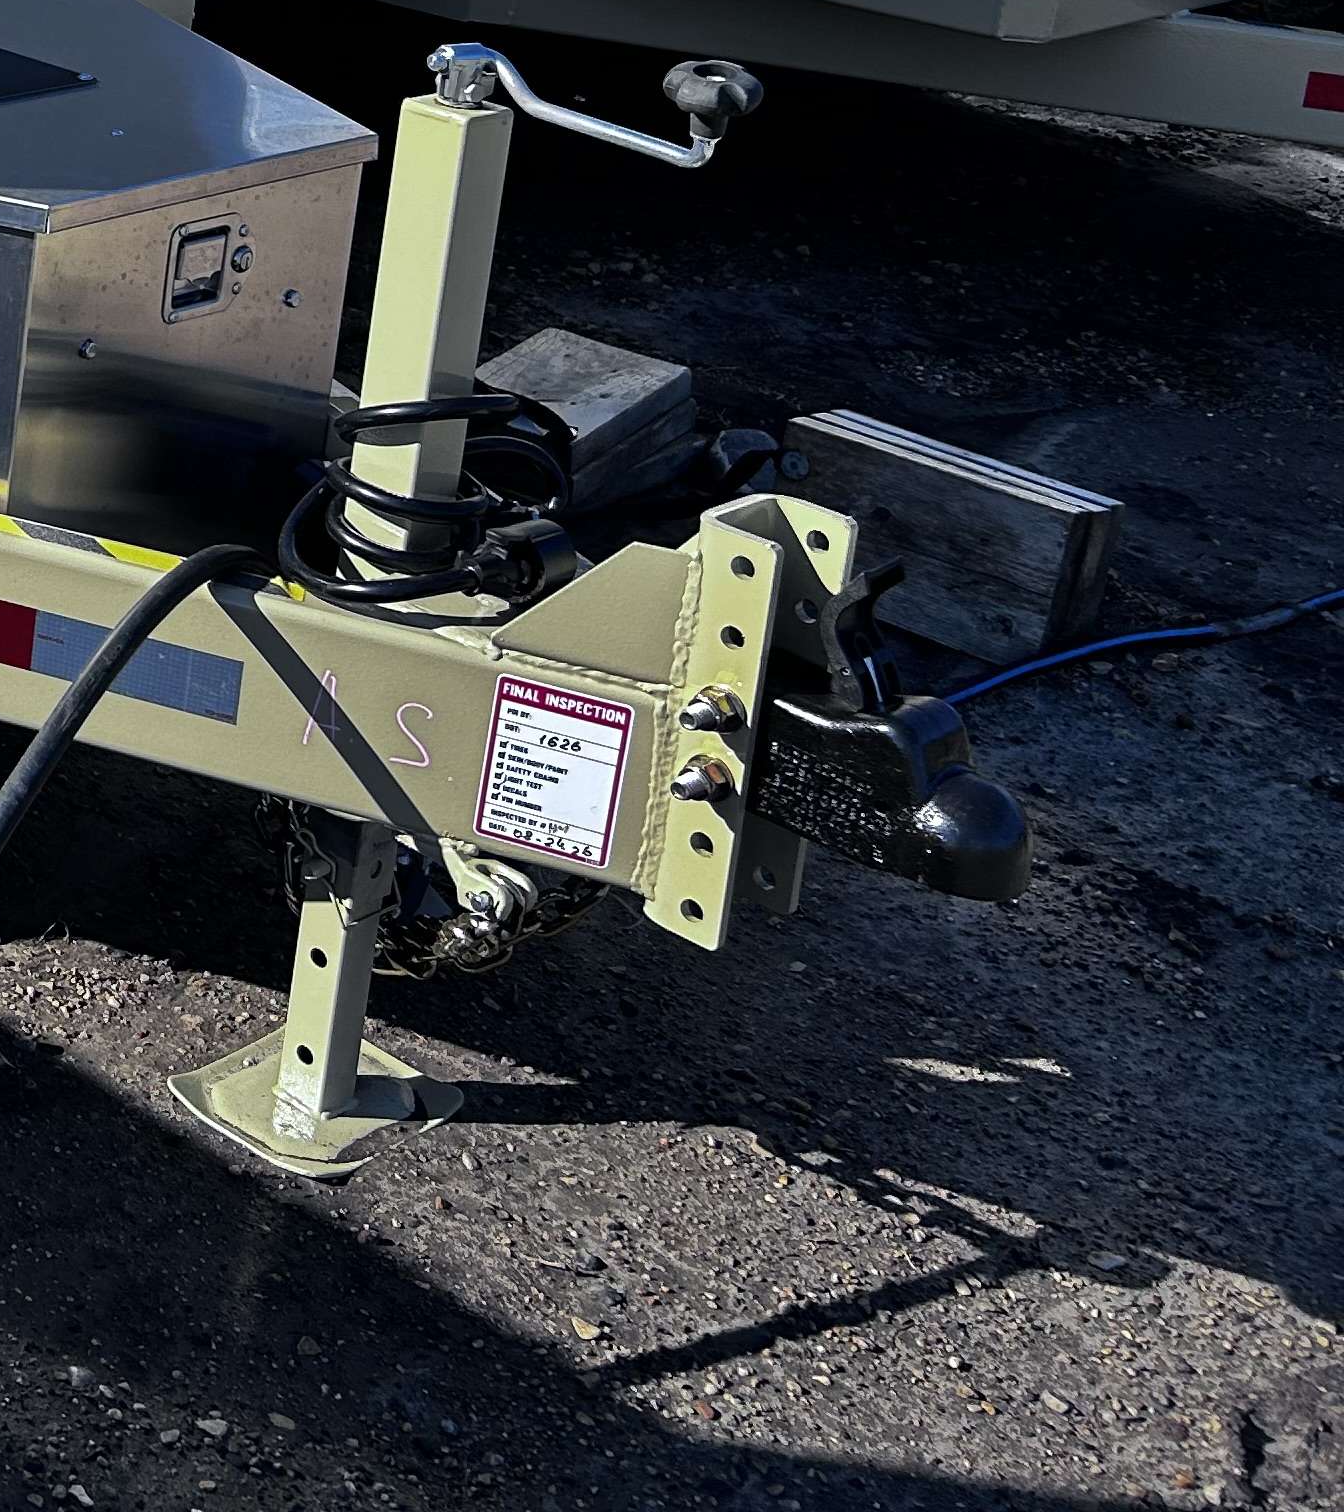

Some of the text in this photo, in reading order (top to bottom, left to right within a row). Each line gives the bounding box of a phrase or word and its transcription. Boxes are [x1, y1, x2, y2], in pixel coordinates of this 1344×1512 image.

[503, 682, 627, 725] FINAL INSPECTION
[539, 734, 582, 753] 1626
[506, 765, 532, 777] SAFETY
[526, 780, 543, 790] TEST
[491, 809, 527, 824] INSPECTED
